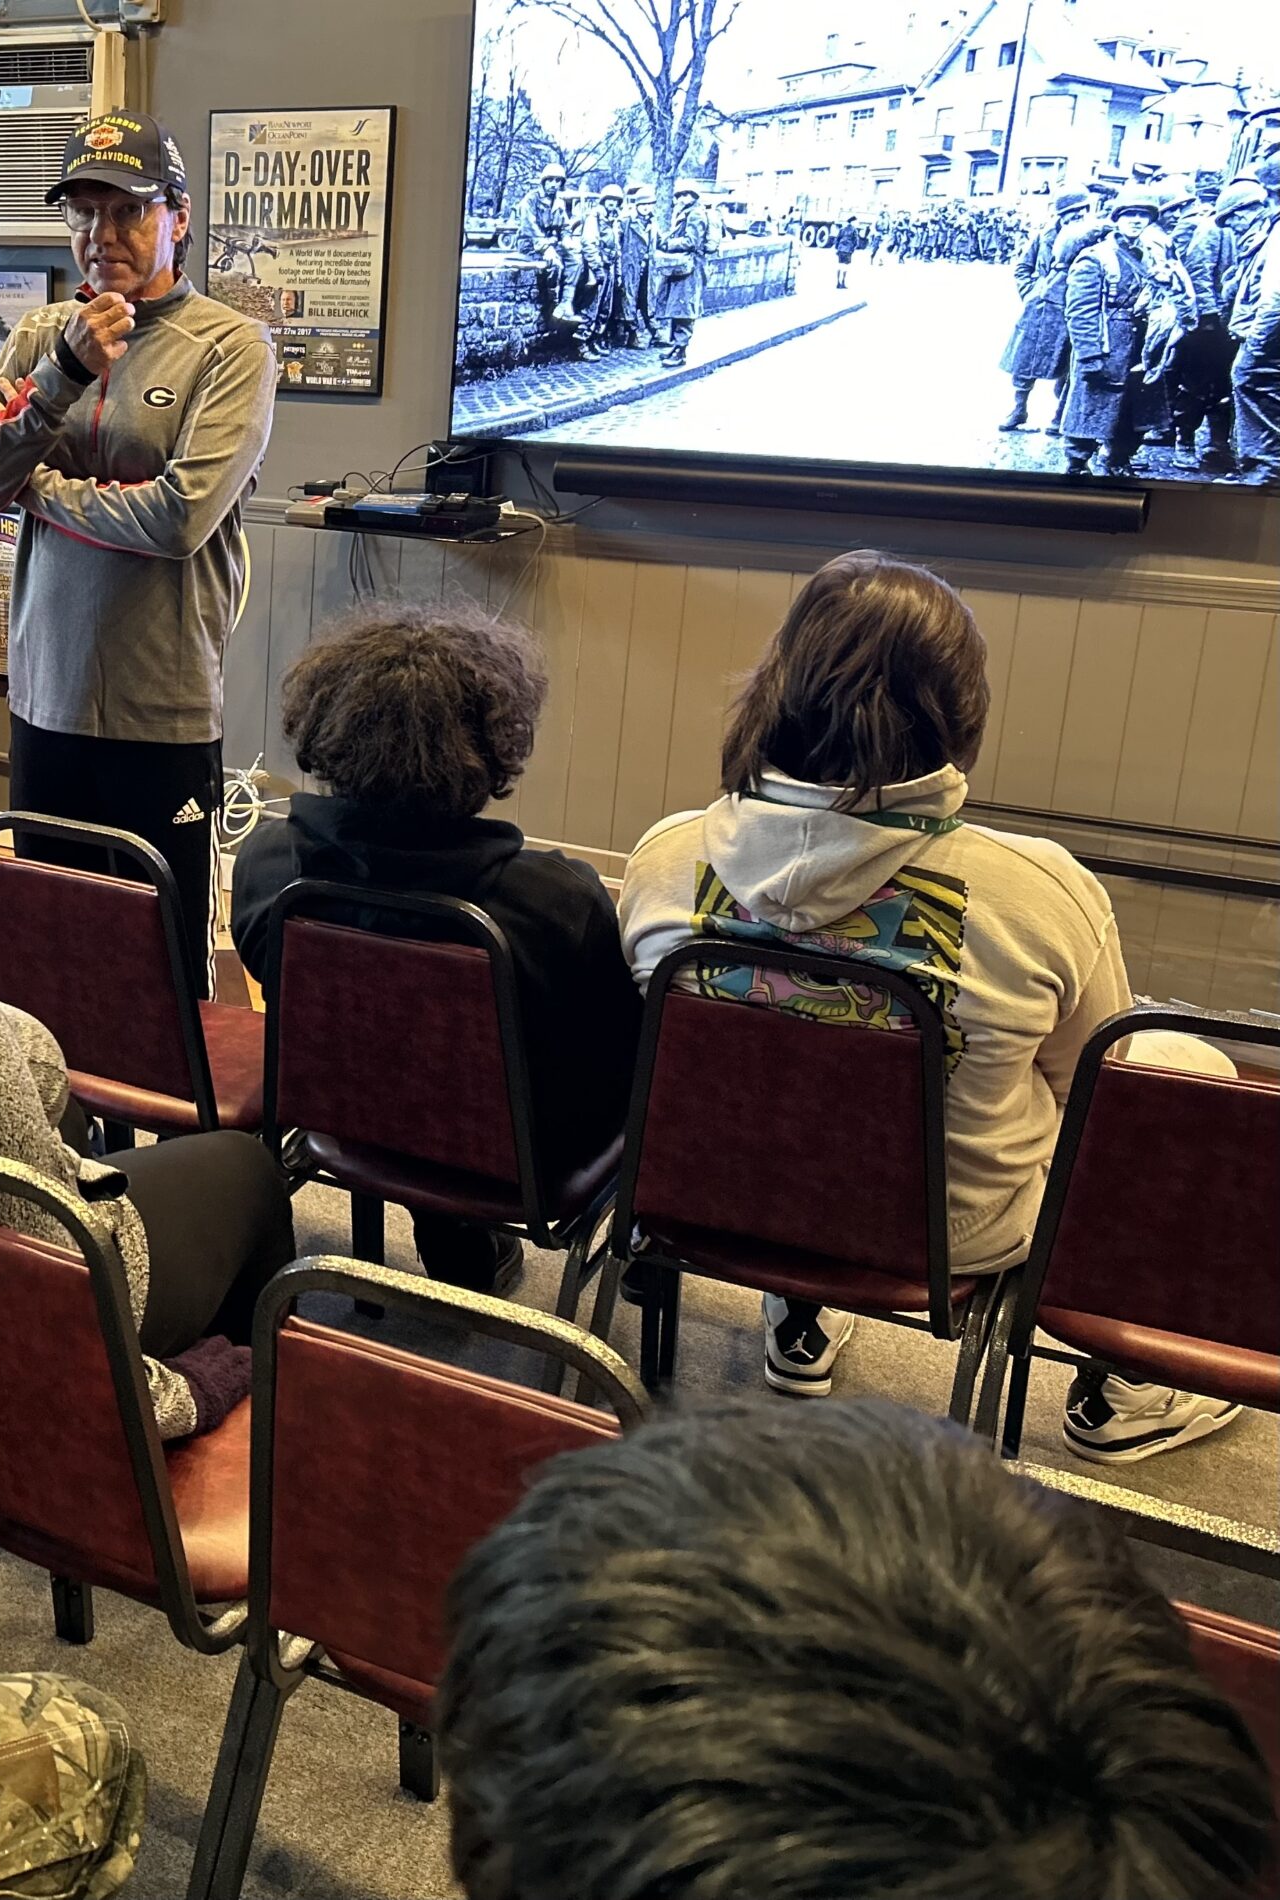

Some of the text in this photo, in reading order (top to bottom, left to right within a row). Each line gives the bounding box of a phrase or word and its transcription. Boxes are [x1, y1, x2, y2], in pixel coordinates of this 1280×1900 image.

[103, 116, 142, 132] HARBOR
[67, 151, 143, 174] HARLEY-DAVIDSON
[224, 191, 371, 231] NORMANDY
[295, 249, 313, 257] World
[333, 249, 372, 258] documentary
[296, 259, 323, 267] featuring
[324, 259, 353, 267] incredible
[279, 267, 300, 276] footage
[327, 268, 345, 276] D-Day
[347, 268, 371, 276] beaches
[299, 277, 331, 286] battlefields
[340, 278, 371, 287] Normandy
[308, 308, 369, 318] BILL BELICHICK
[297, 328, 312, 336] 2017
[143, 386, 177, 409] G
[172, 811, 205, 824] adidas
[908, 816, 929, 830] VT
